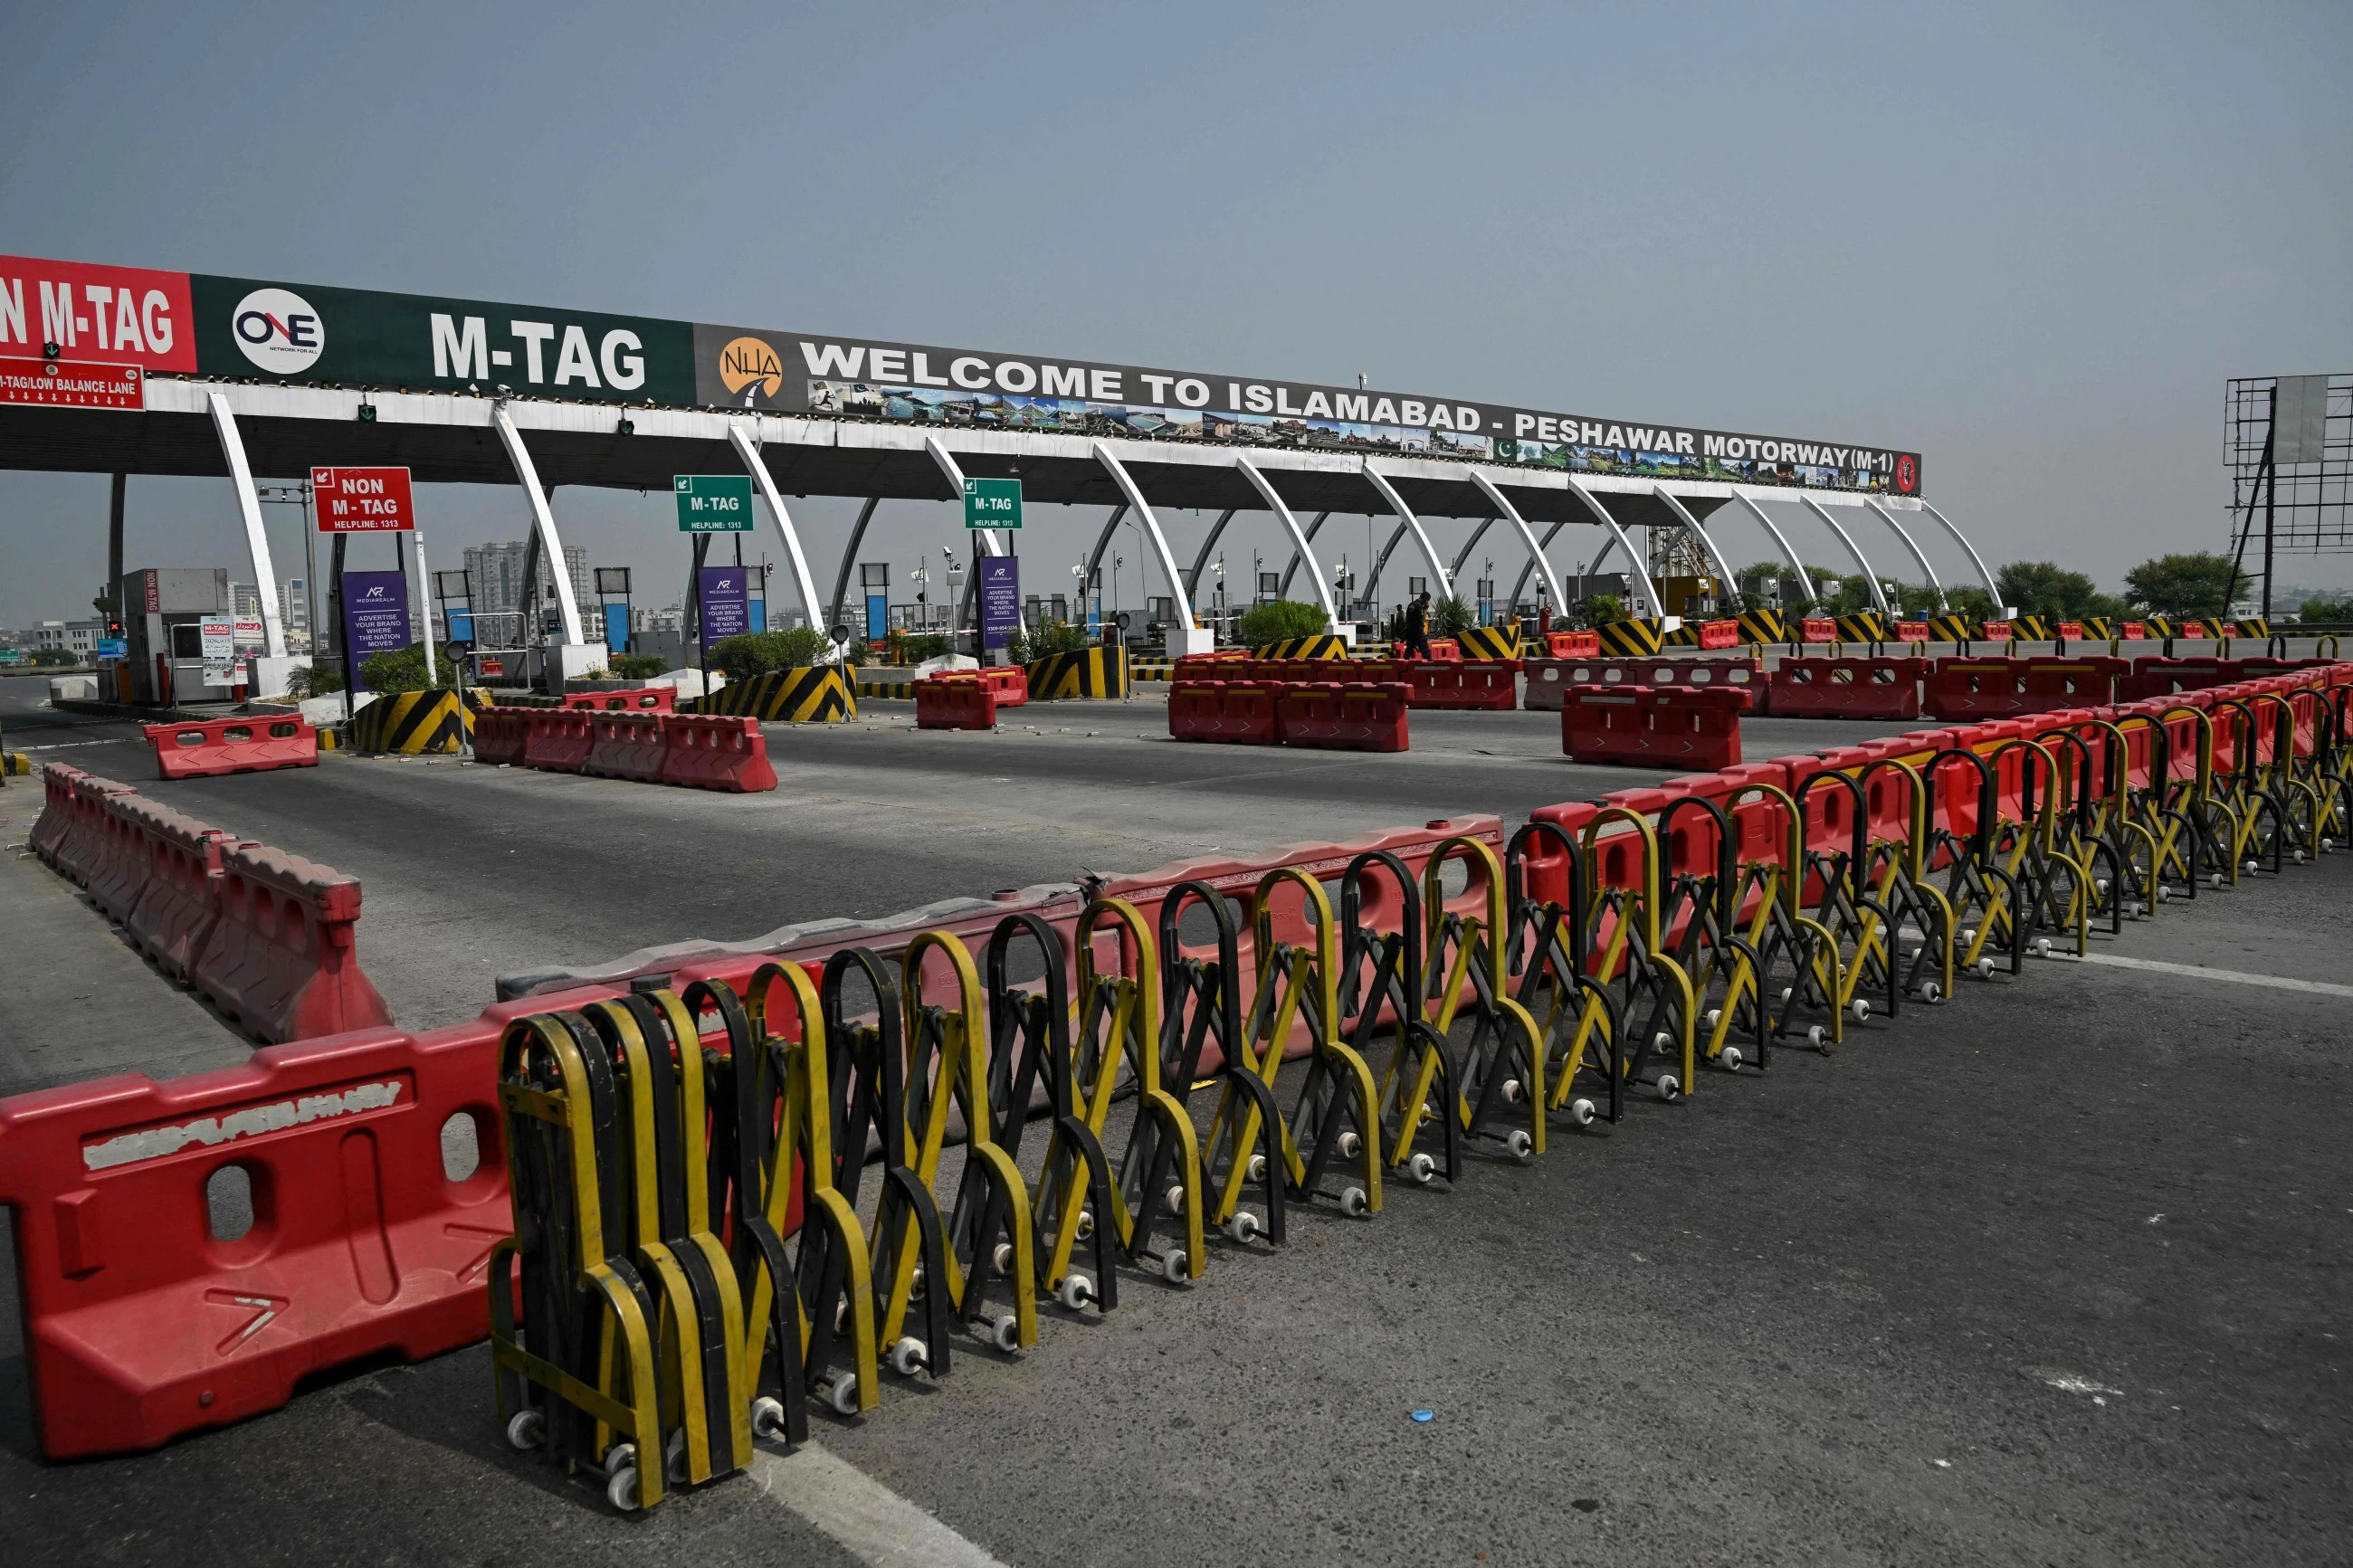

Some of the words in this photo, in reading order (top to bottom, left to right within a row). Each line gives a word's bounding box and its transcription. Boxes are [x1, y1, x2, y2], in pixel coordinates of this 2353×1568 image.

[39, 280, 174, 355] M-TAG
[236, 310, 318, 348] ONE
[430, 312, 646, 391] M-TAG
[725, 346, 781, 378] NHA
[56, 378, 106, 394] BALANCE
[108, 381, 136, 395] LANE
[799, 341, 1123, 401] WELCOME
[1140, 374, 1210, 407] TO
[1229, 382, 1481, 432] ISLAMABAD
[1515, 413, 1694, 454] PESHAWAR
[1703, 435, 1849, 469] MOTORWAY
[1851, 449, 1894, 473] (M-1)
[341, 479, 384, 494] NON
[334, 520, 378, 528] HELPLINE:
[380, 519, 398, 527] 1313
[147, 572, 156, 587] NON
[148, 589, 157, 611] M-TAG
[358, 613, 397, 622] ADVERTISE
